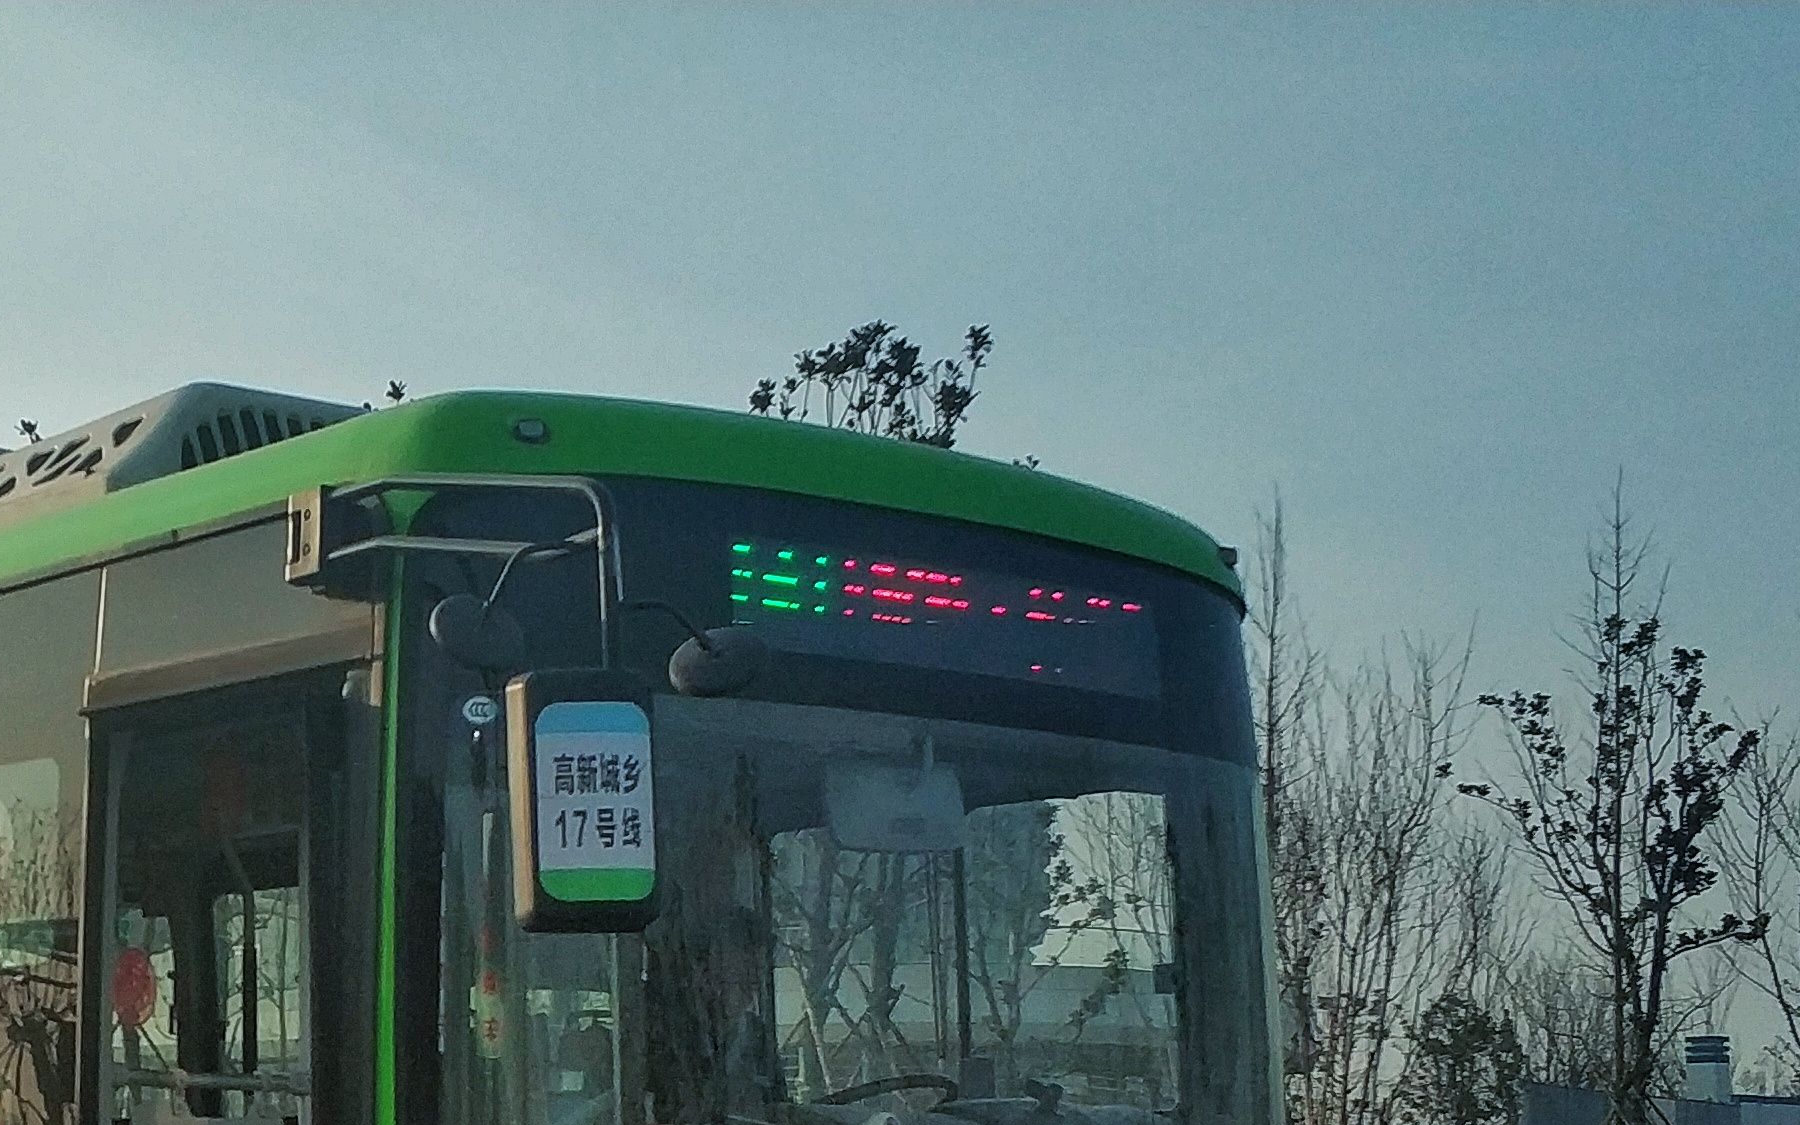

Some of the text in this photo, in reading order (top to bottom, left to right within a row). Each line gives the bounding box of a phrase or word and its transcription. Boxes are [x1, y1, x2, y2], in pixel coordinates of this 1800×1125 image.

[553, 753, 641, 795] 高新城乡
[555, 806, 642, 848] 17号线
